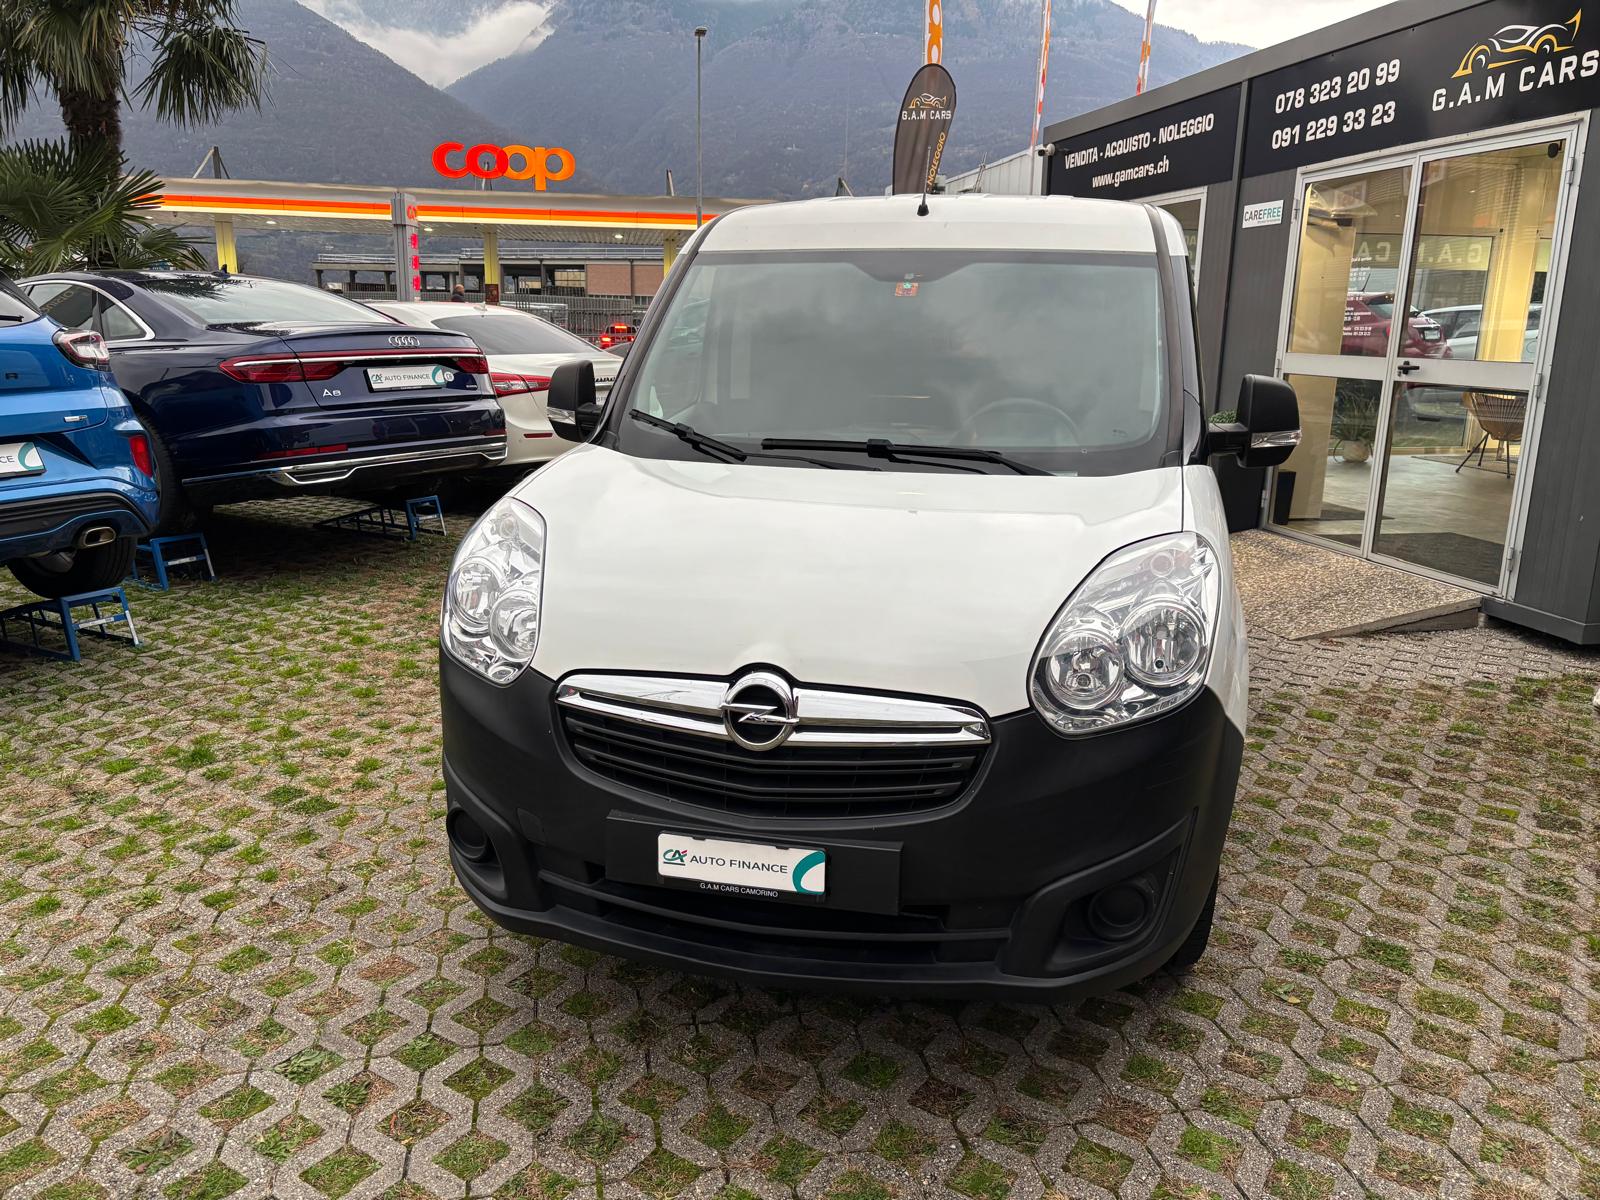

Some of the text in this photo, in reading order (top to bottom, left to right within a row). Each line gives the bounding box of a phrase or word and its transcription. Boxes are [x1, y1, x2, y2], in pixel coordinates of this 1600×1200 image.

[1275, 59, 1400, 114] 078 323 20 99
[1432, 50, 1600, 111] G.A.M CARS
[901, 110, 951, 120] G.A.M CARS
[1272, 101, 1396, 149] 091 229 33 23
[1065, 147, 1098, 169] VENDITA
[1104, 132, 1151, 159] ACQUISTO
[1158, 113, 1215, 144] NOLEGGIO
[431, 141, 576, 191] coop
[927, 131, 946, 186] NOLEGGIO
[1092, 155, 1170, 188] www.gamcars.ch
[1244, 206, 1281, 222] CAREFREE
[322, 388, 342, 398] A8
[402, 373, 430, 381] FINANCE
[690, 855, 726, 867] AUTO
[729, 859, 788, 874] FINANCE
[720, 884, 740, 893] CARS
[741, 887, 778, 898] CAMORINO
